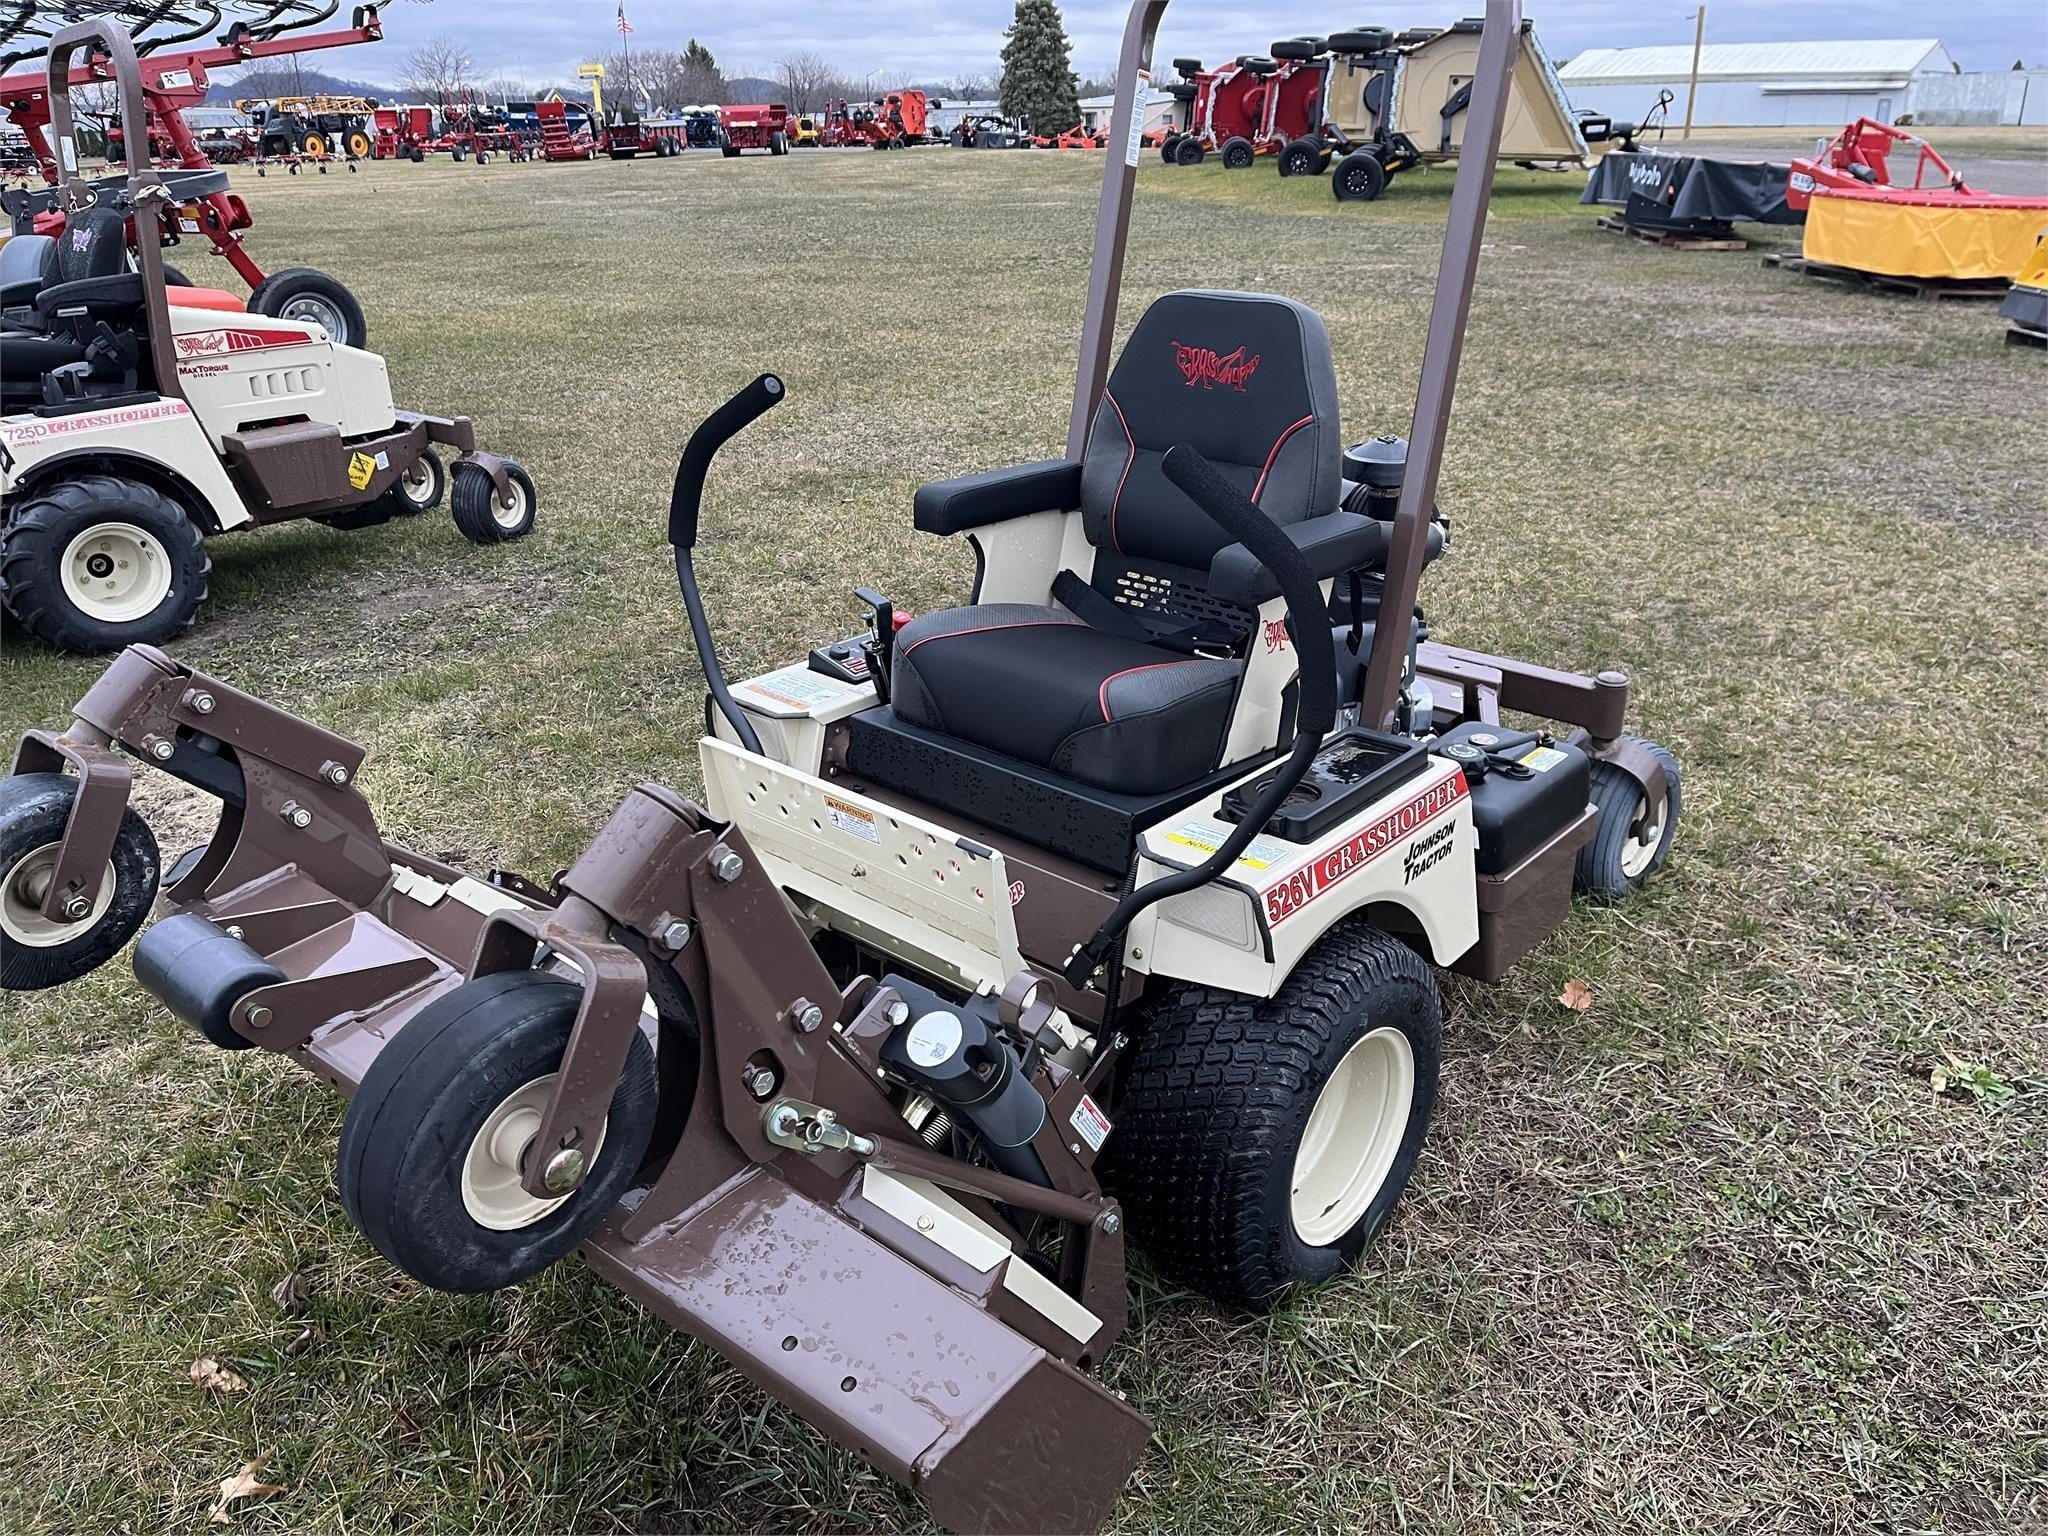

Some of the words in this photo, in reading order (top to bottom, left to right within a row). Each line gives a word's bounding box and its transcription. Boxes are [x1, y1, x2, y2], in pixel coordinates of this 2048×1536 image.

[4, 425, 47, 441] 725D
[53, 404, 179, 433] GRASSHOPPER
[832, 801, 873, 821] WARNING
[1266, 865, 1314, 922] 526V
[1324, 777, 1458, 881] GRASSHOPPER
